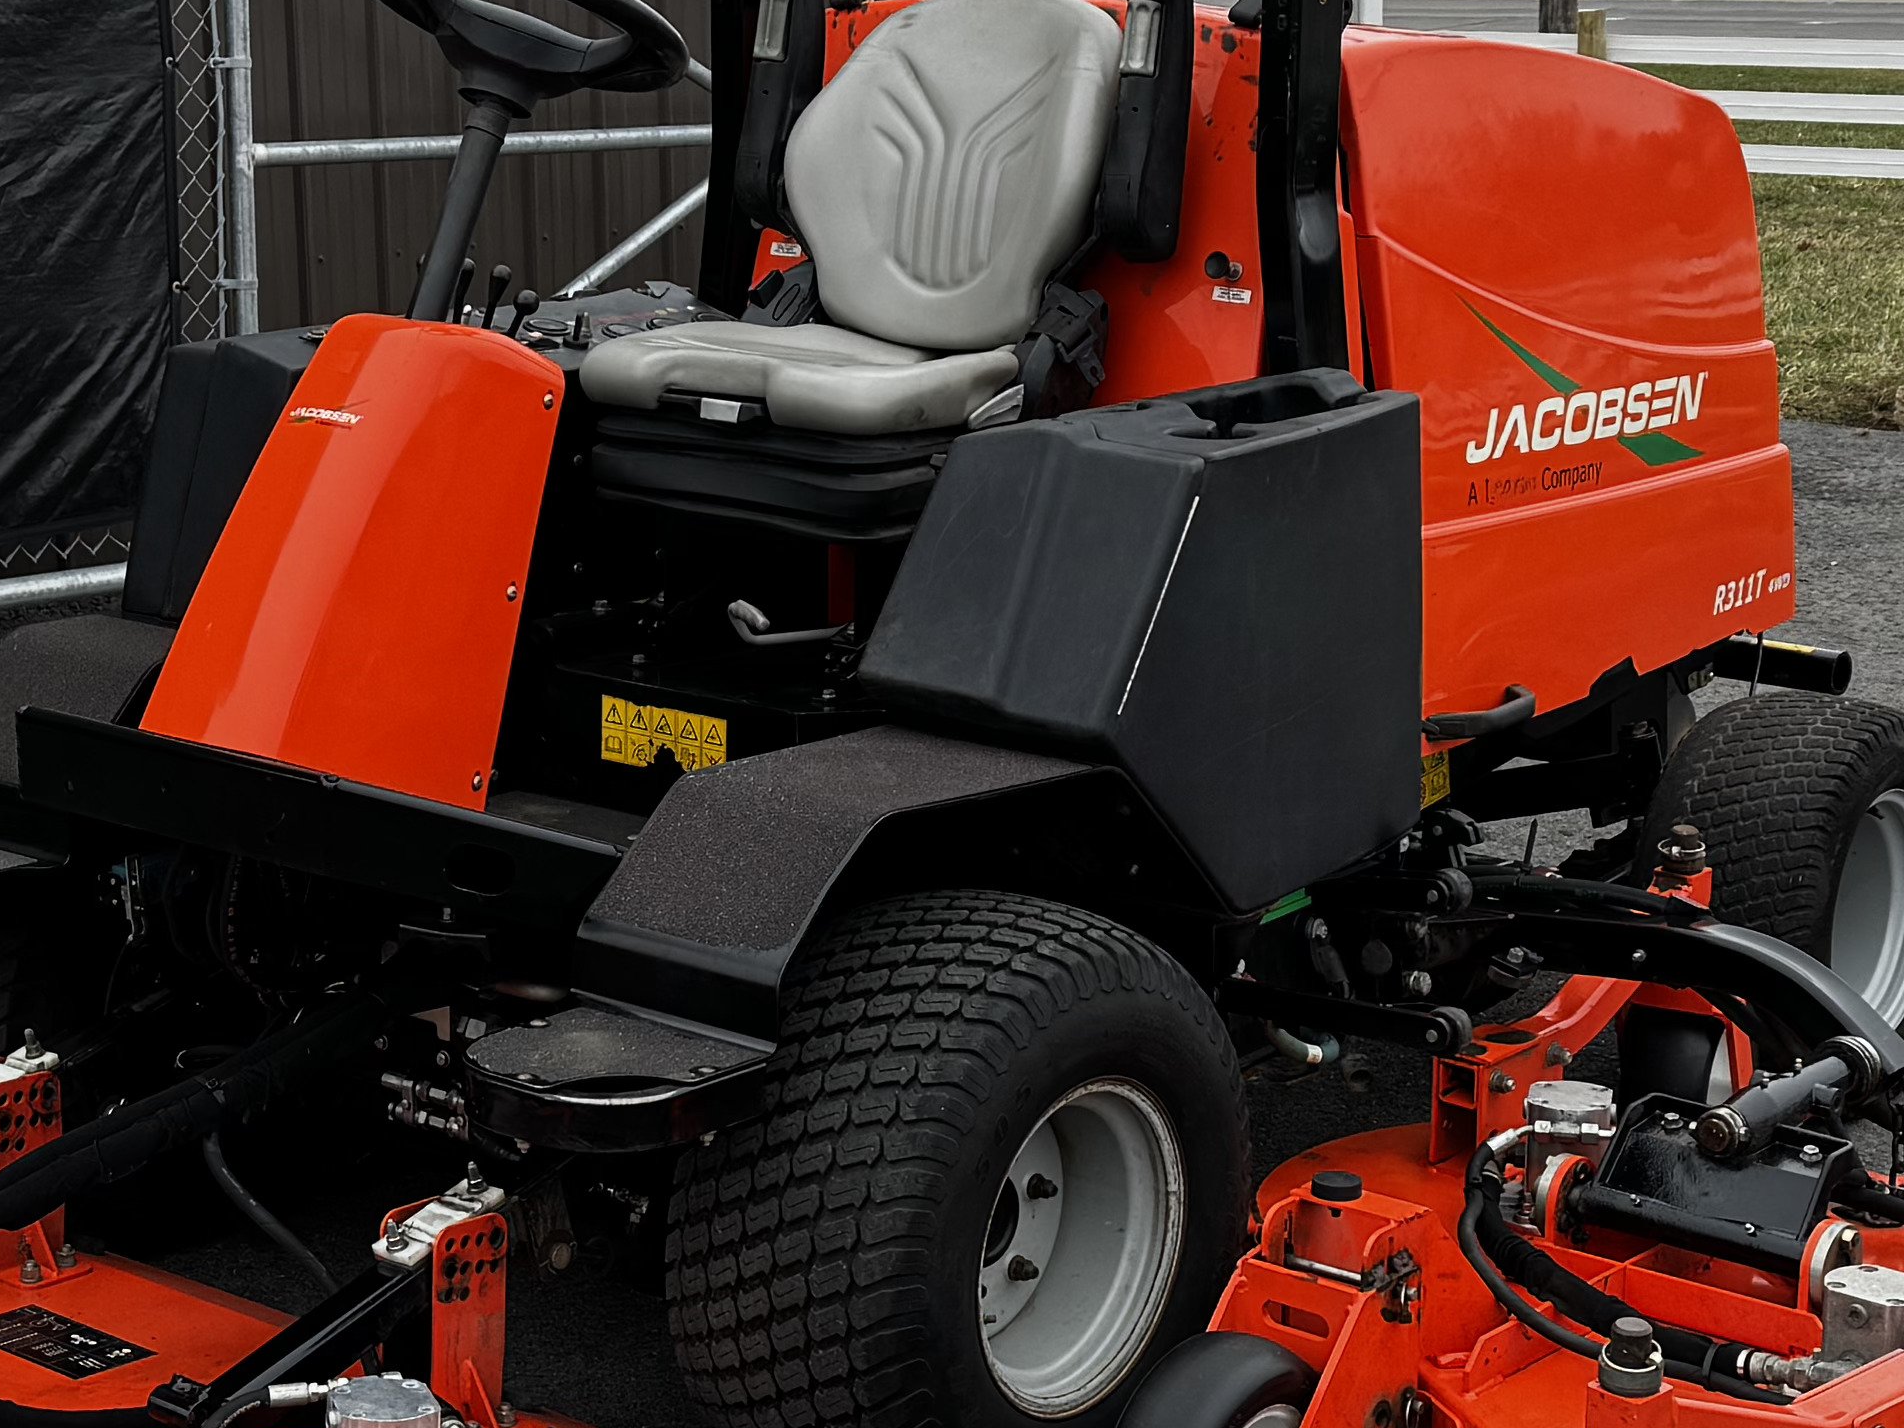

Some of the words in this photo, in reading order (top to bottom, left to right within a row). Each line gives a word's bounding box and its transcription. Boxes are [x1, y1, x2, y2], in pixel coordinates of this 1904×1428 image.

[1465, 371, 1707, 465] JACOBSEN
[1467, 481, 1479, 506] A
[1541, 461, 1603, 491] Company
[1713, 568, 1768, 616] R311T
